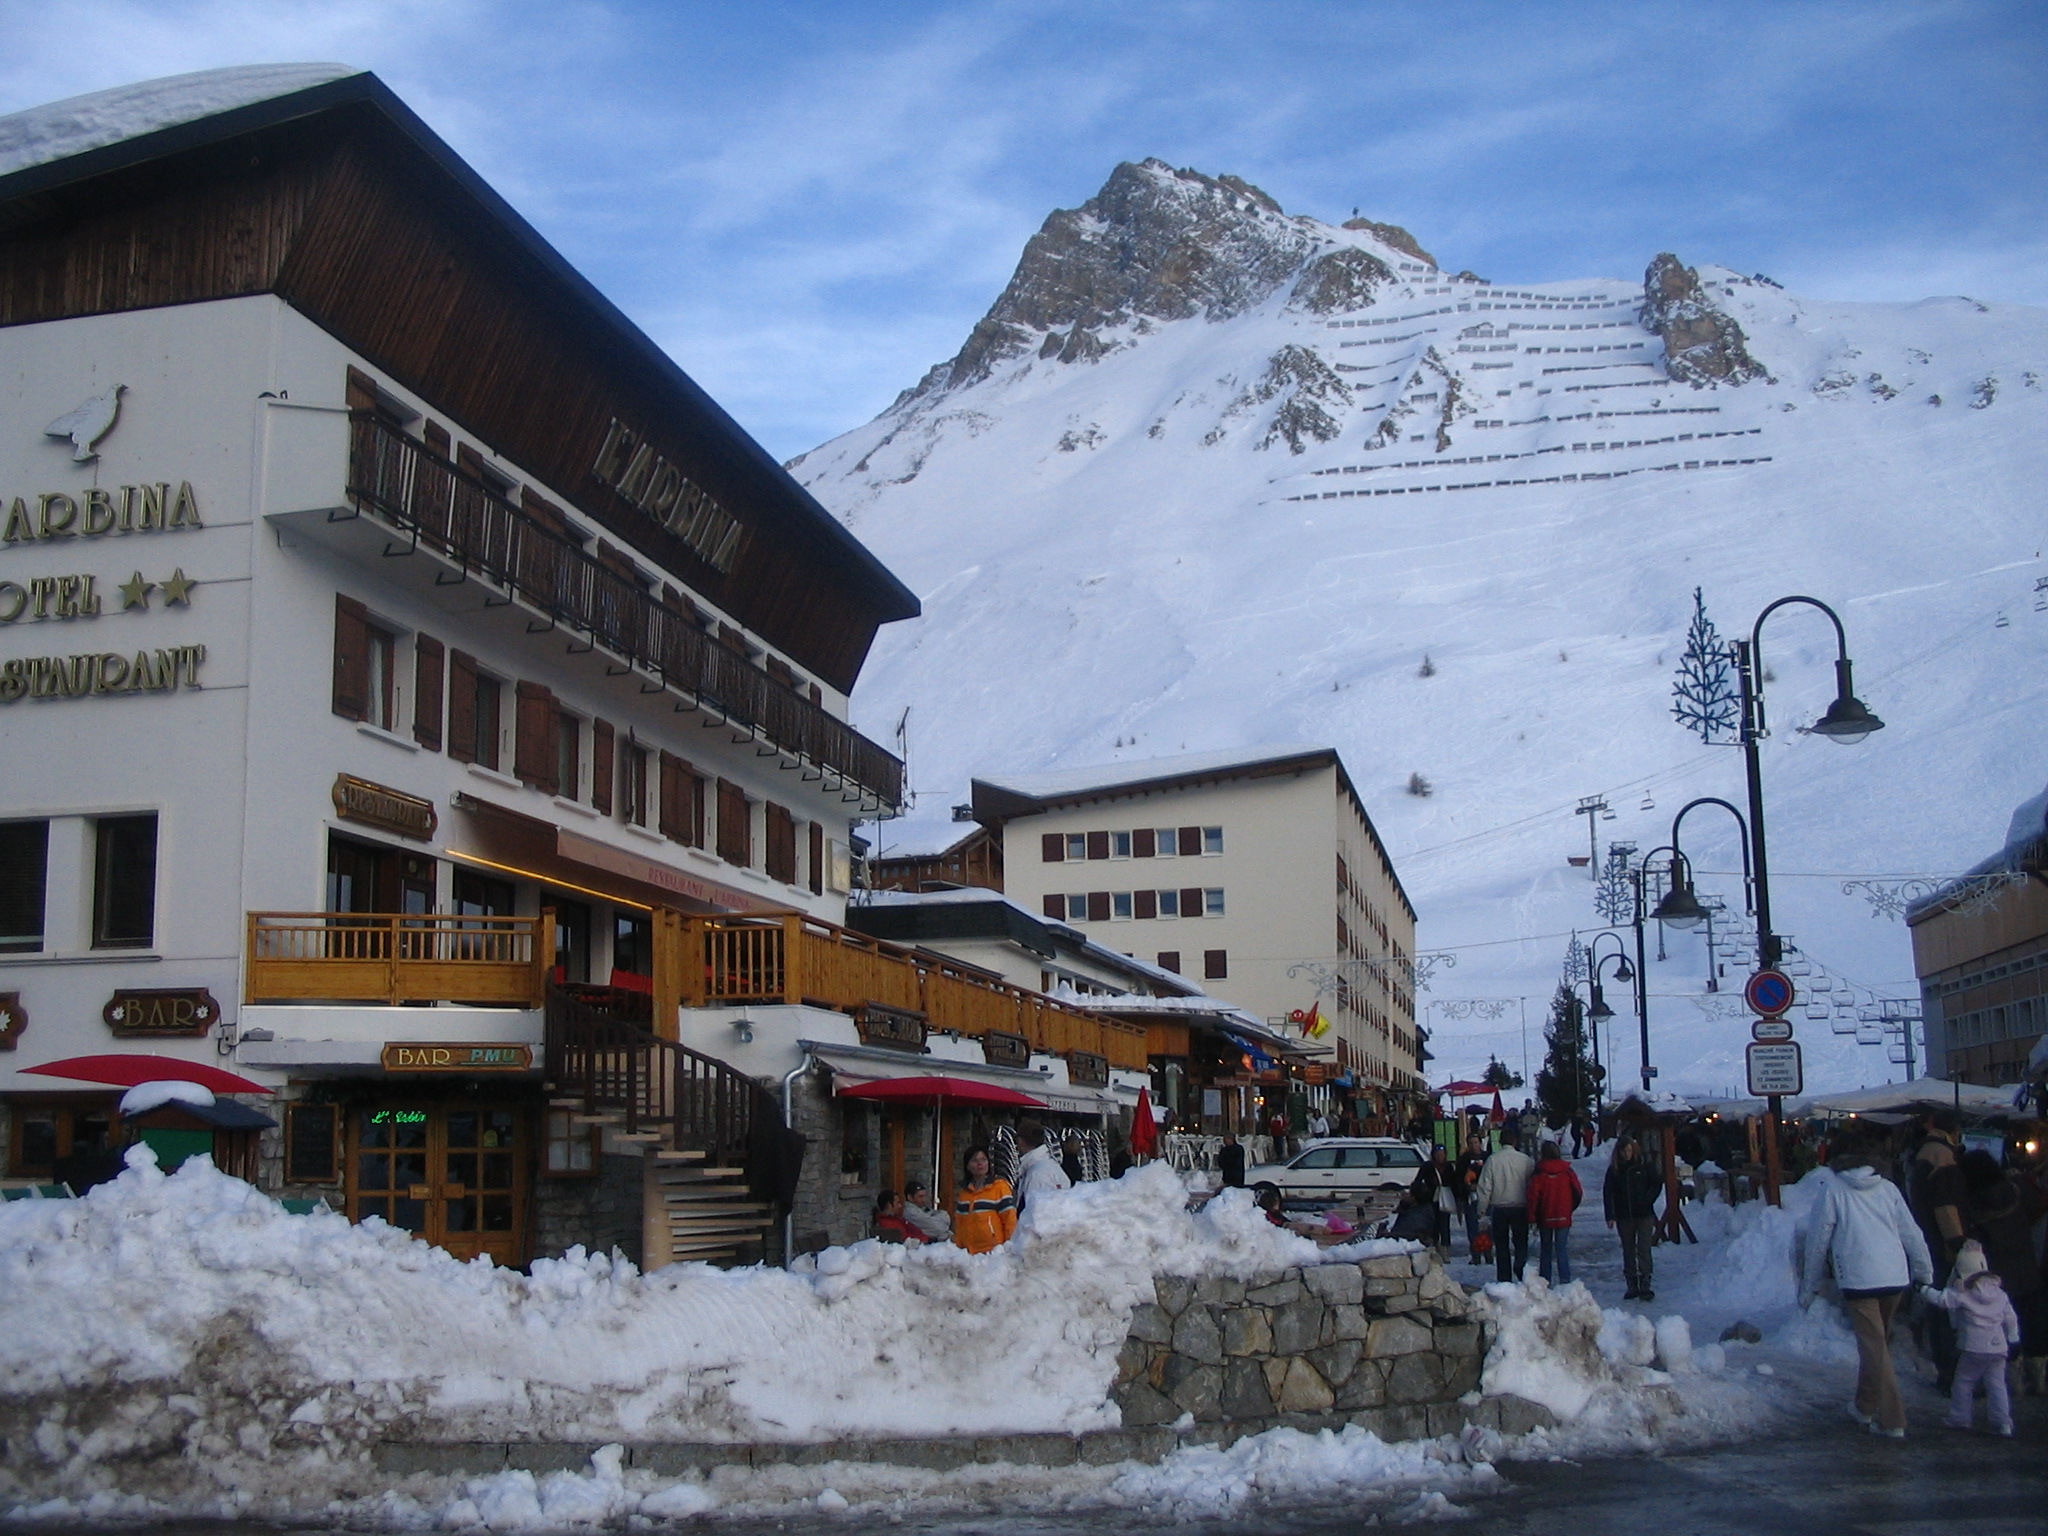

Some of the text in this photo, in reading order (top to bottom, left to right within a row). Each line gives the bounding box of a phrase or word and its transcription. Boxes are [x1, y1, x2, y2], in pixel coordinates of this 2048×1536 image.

[124, 999, 197, 1026] BAR
[398, 1047, 516, 1065] BAR PMU
